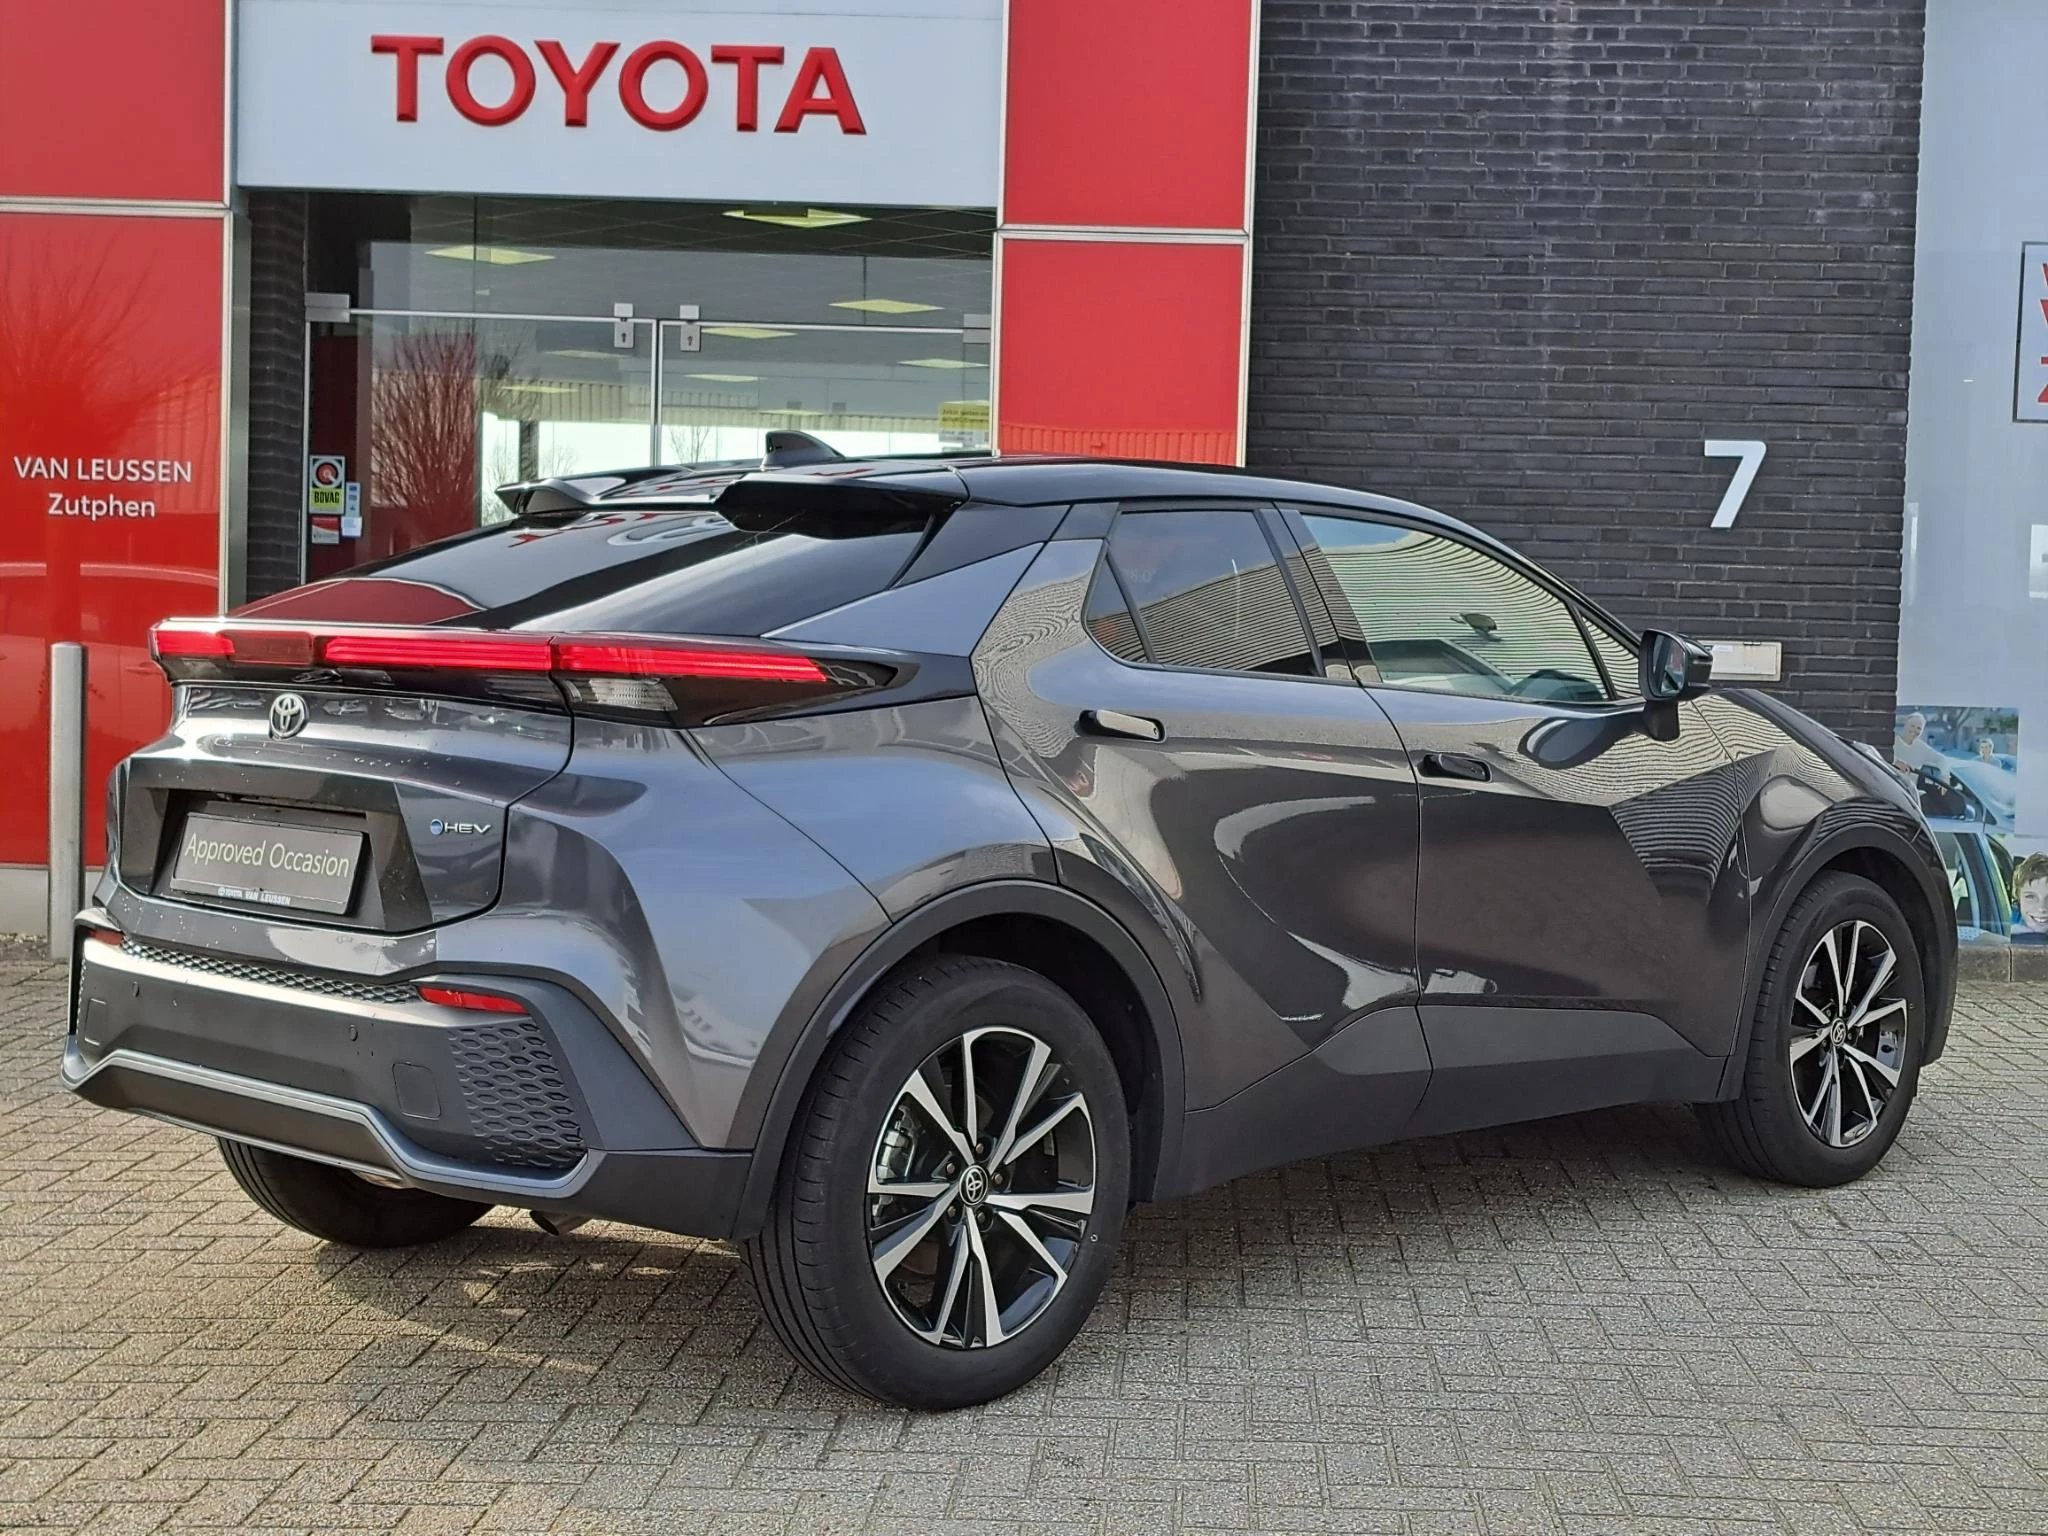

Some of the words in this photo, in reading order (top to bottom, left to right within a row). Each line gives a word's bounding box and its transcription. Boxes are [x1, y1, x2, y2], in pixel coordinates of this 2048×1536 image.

[371, 34, 867, 135] TOYOTA
[13, 456, 68, 480] VAN
[77, 458, 192, 483] LEUSSEN
[1703, 439, 1767, 528] 7
[48, 492, 156, 521] Zutphen
[314, 491, 340, 504] BOVAG
[444, 822, 491, 834] HEV
[184, 832, 266, 866] Approved
[269, 842, 350, 878] Occasion
[245, 890, 259, 901] VAN
[260, 893, 292, 906] LEUSSEN
